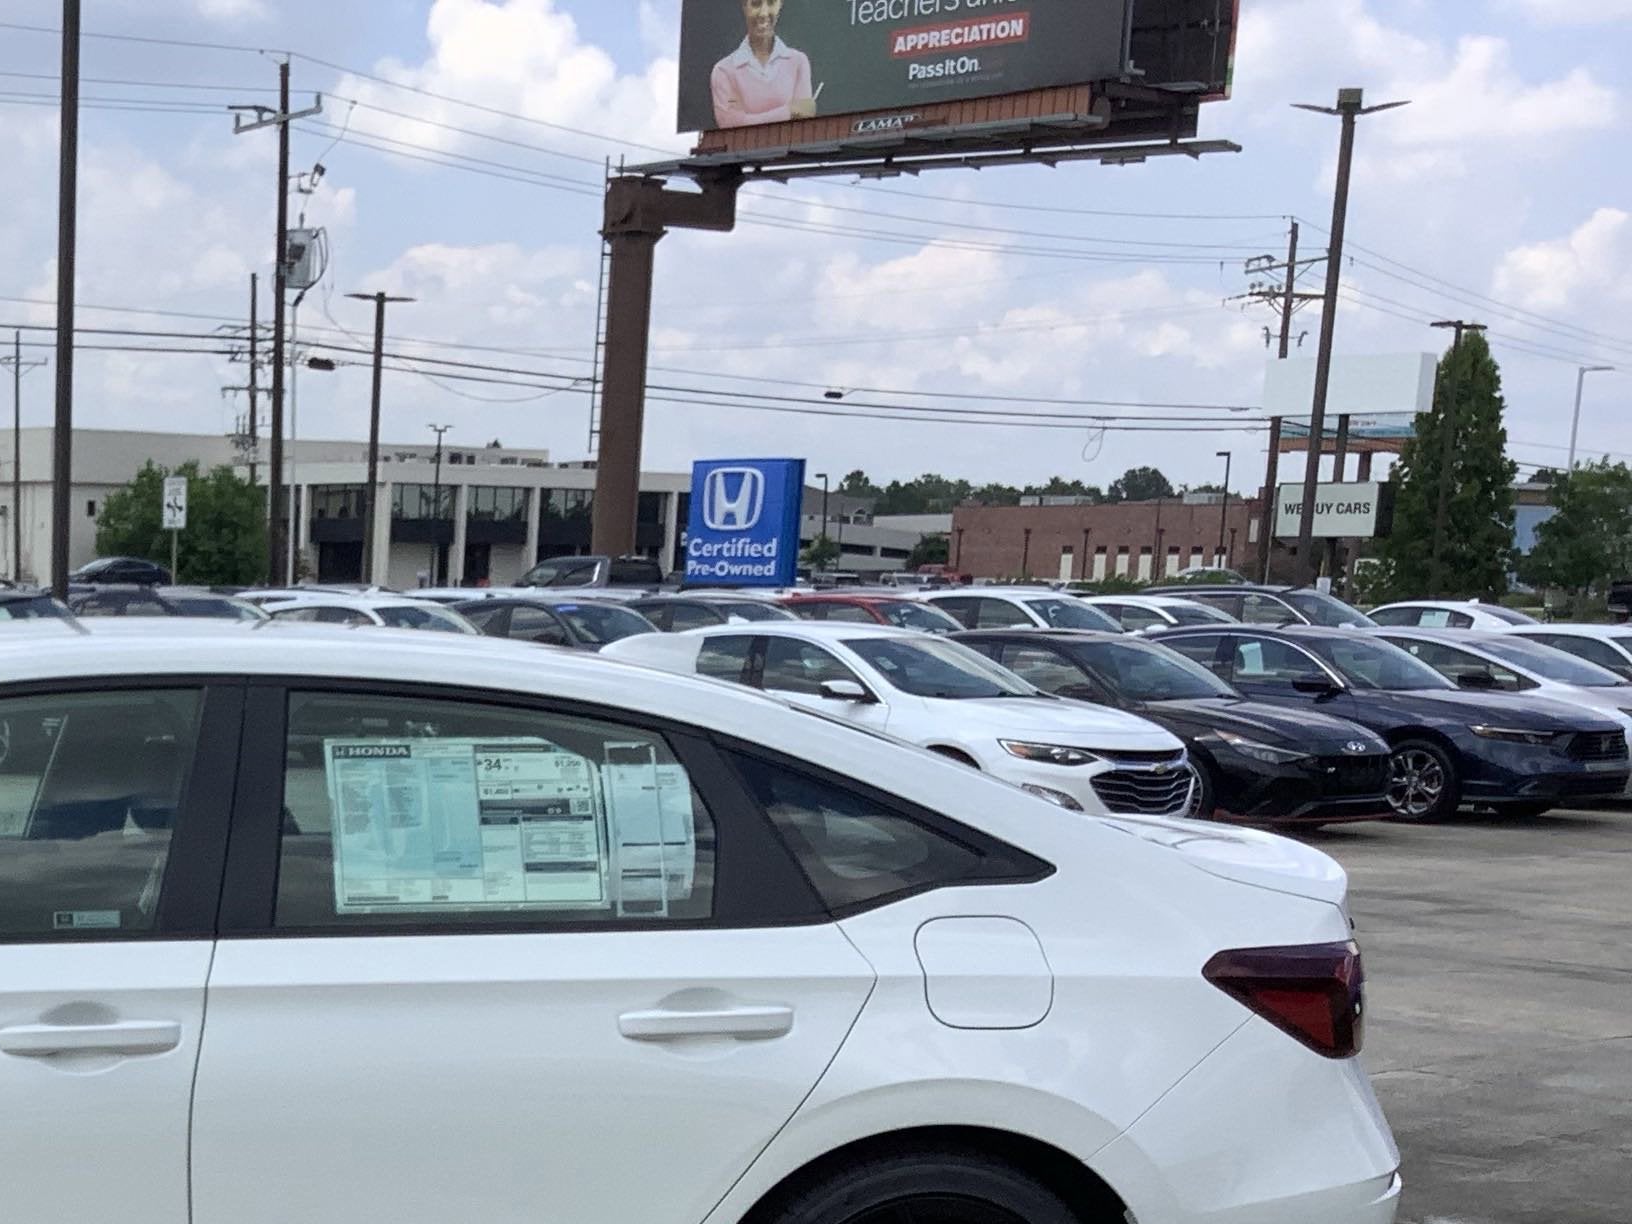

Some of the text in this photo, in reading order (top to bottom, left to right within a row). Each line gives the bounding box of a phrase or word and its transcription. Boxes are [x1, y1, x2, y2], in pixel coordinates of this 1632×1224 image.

[894, 19, 1024, 53] APPRECIATION
[1336, 503, 1371, 515] CARS
[689, 537, 778, 557] Certified
[687, 560, 776, 577] Pre-Owned
[348, 746, 409, 756] HONDA
